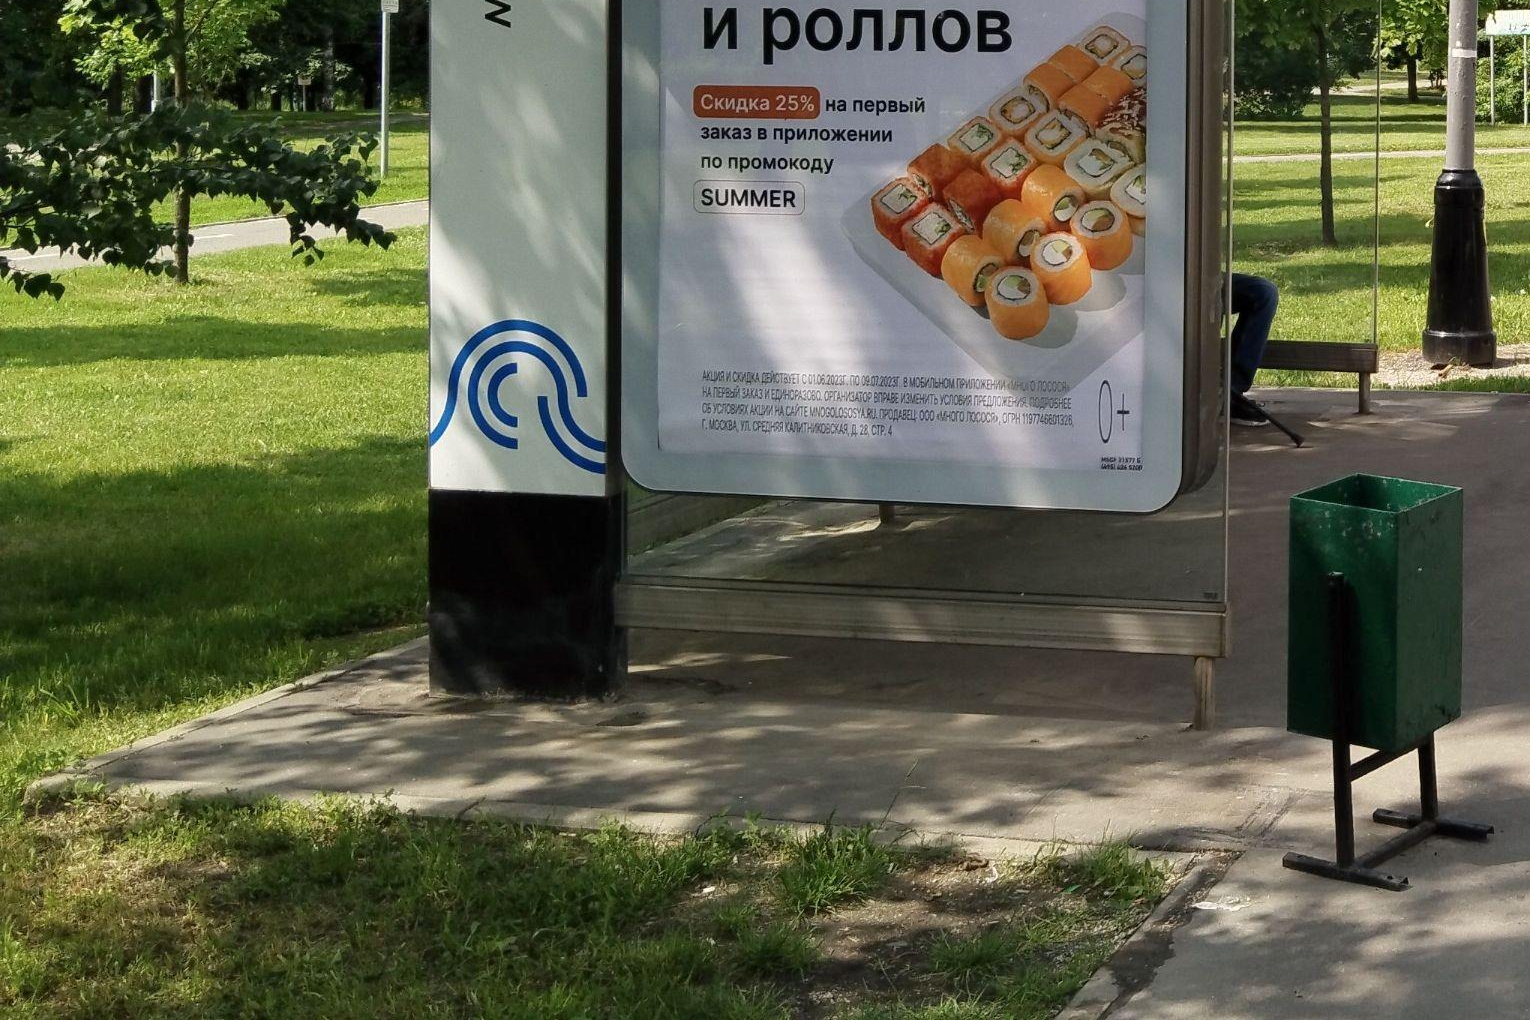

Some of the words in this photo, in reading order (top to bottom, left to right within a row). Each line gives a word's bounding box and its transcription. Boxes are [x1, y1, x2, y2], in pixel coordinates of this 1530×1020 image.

[703, 7, 738, 50] и
[762, 7, 1013, 65] роллов
[700, 94, 770, 113] Скидка
[775, 95, 815, 112] 25%
[825, 99, 847, 112] на
[852, 97, 926, 116] первый
[700, 127, 752, 140] заказ
[758, 129, 768, 140] в
[773, 128, 893, 144] приложении
[701, 155, 722, 168] по
[728, 156, 834, 174] промокоду
[700, 188, 796, 208] SUMMER
[702, 370, 725, 382] АКЦИЯ
[732, 371, 760, 385] СКИДКА
[761, 370, 800, 385] ДЕЙСТВУЕТ
[909, 377, 955, 389] МОБИЛЬНОМ
[956, 378, 1006, 390] ПРИЛОЖЕНИИ
[702, 387, 711, 398] НА
[713, 385, 740, 399] ПЕРВЫЙ
[742, 388, 763, 400] ЗАКАЗ
[824, 390, 872, 403] ОРГАНИЗАТОР
[873, 392, 899, 404] ВПРАВЕ
[900, 393, 939, 405] ИЗМЕНИТЬ
[940, 394, 973, 406] УСЛОВИЯ
[712, 403, 749, 415] УСЛОВИЯХ
[750, 404, 774, 416] АКЦИИ
[774, 405, 784, 417] НА
[786, 403, 808, 417] САЙТЕ
[919, 410, 935, 422] ООО
[1002, 413, 1020, 425] ОГРН
[1098, 379, 1130, 444] 0+
